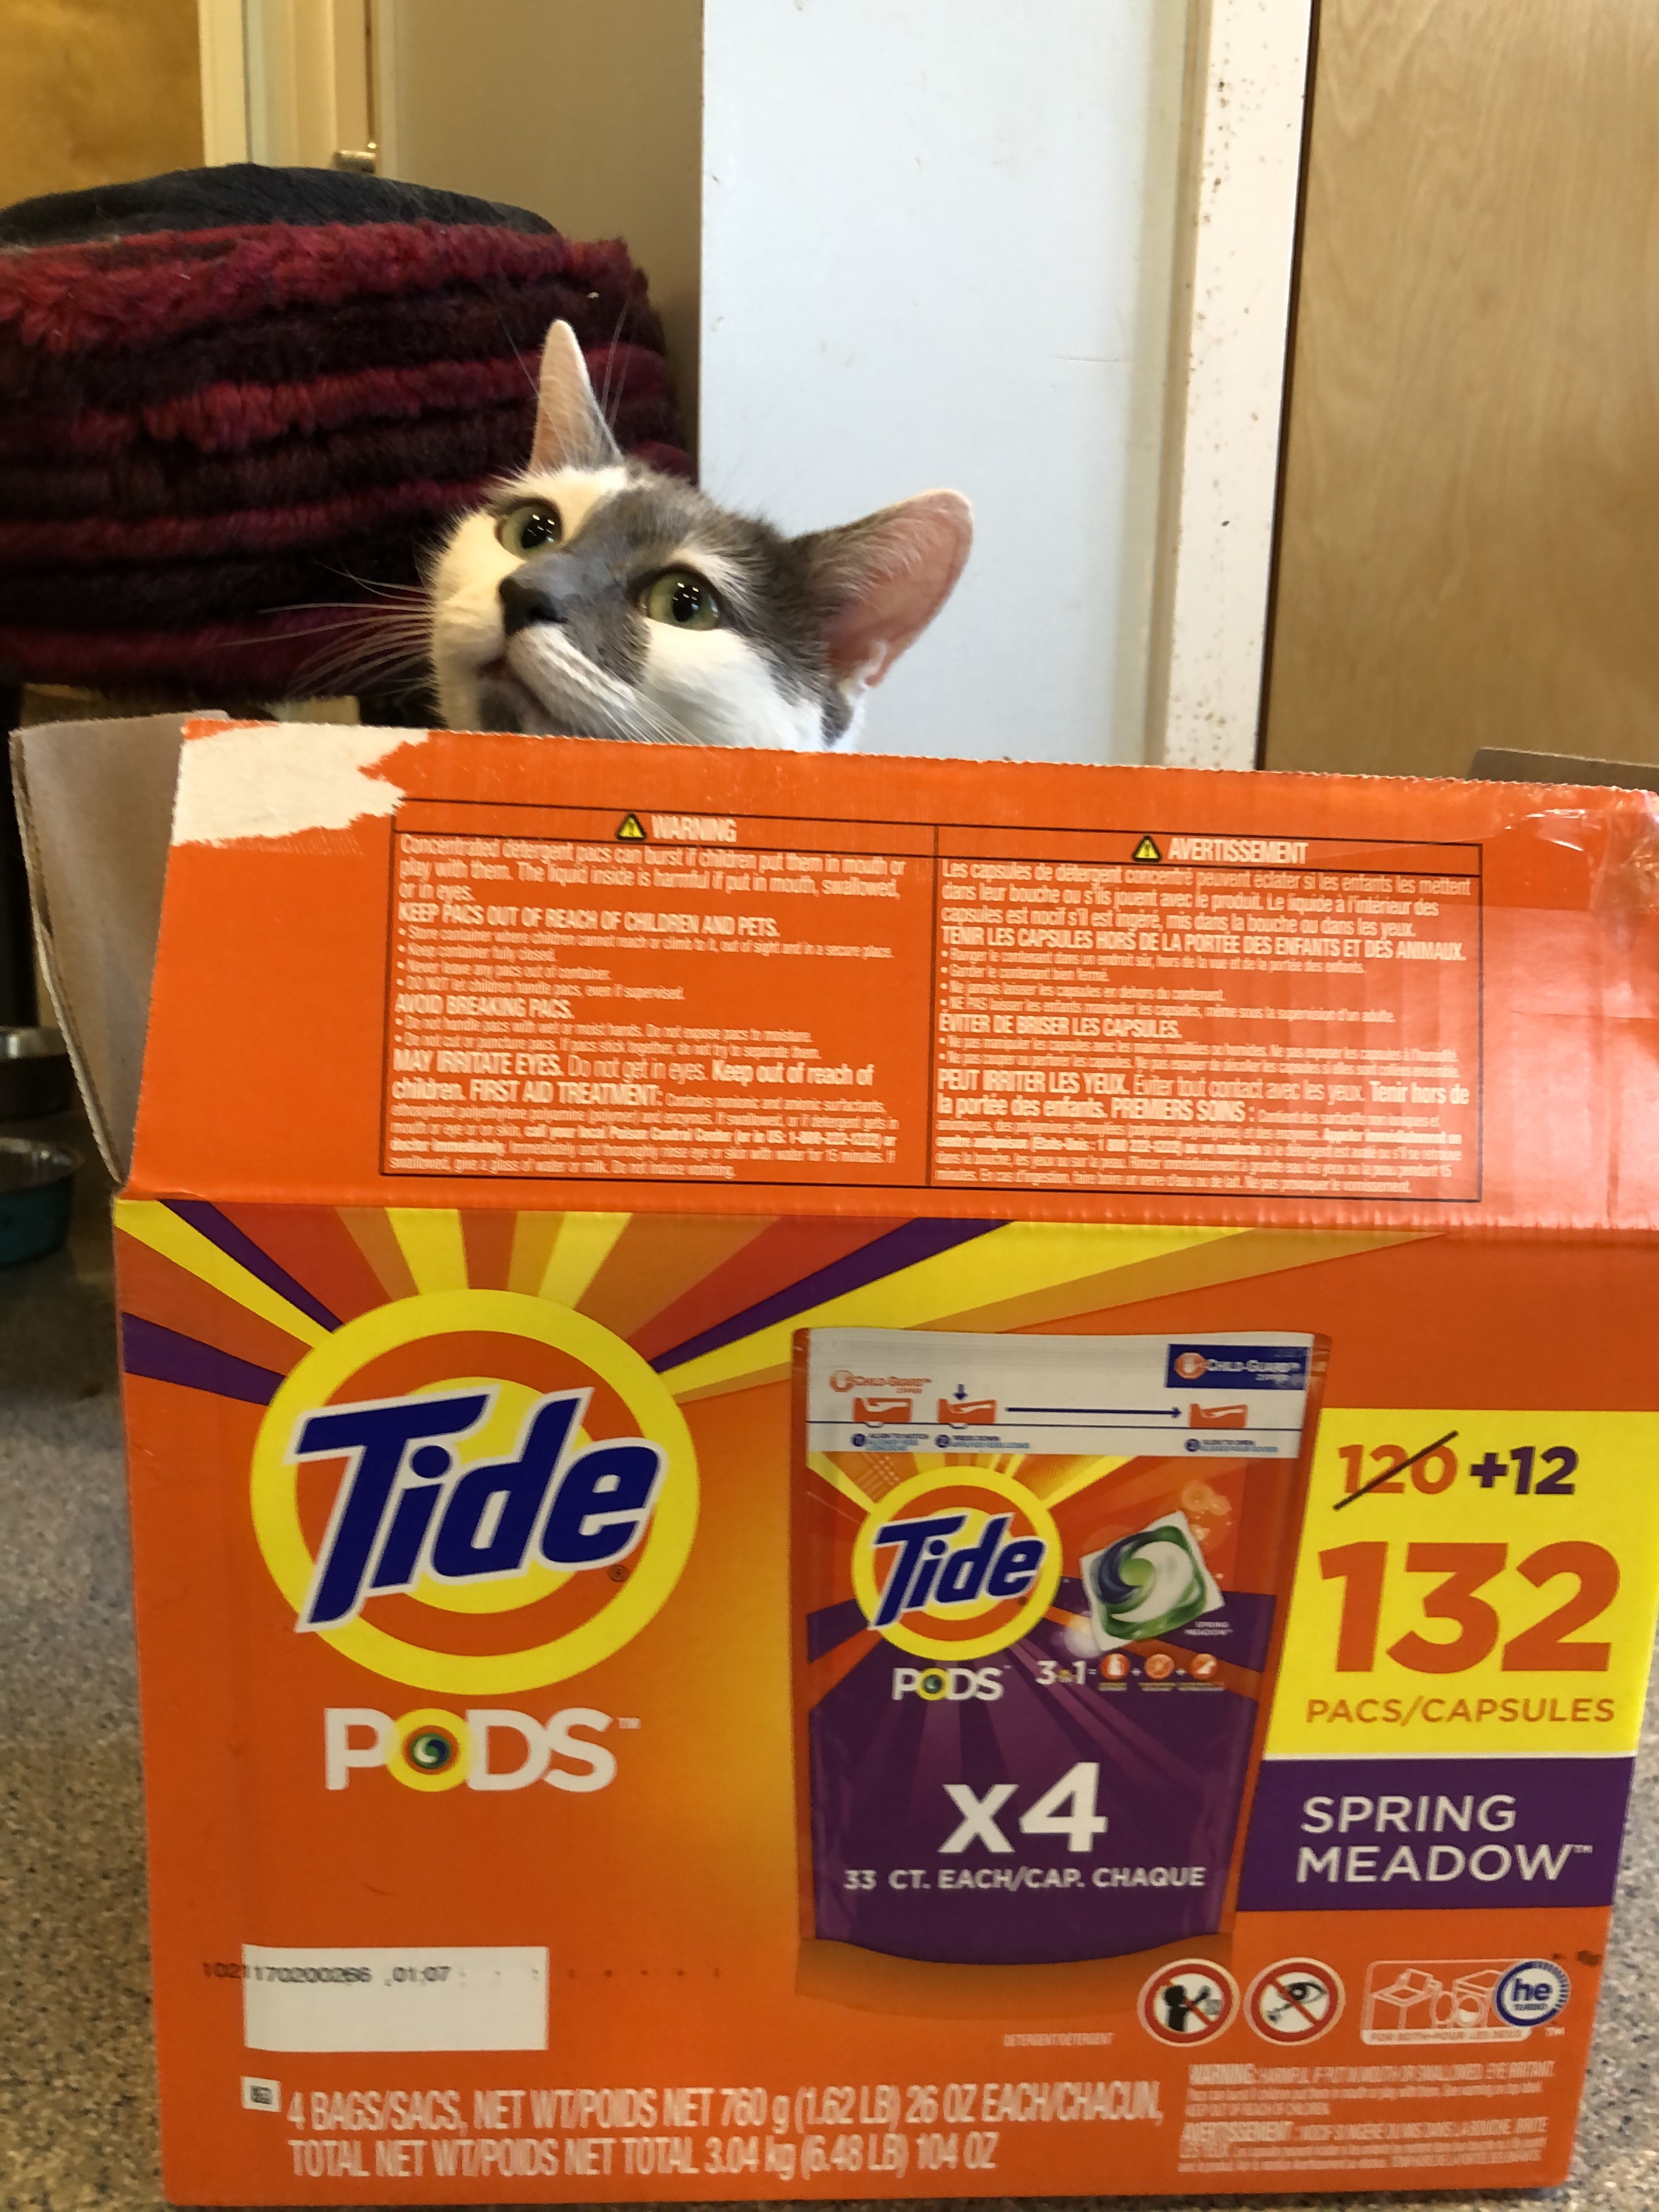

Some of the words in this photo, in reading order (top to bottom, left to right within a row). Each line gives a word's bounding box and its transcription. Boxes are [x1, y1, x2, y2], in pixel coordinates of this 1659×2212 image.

[651, 815, 737, 842] WARNING
[1169, 837, 1307, 864] AVERTISSEMENT
[1338, 1443, 1458, 1494] 120
[1470, 1446, 1578, 1494] +12
[284, 1384, 667, 1633] Tide
[868, 1513, 1046, 1630] Tide
[1319, 1541, 1620, 1674] 132
[892, 1667, 1005, 1701] PODS
[1306, 1696, 1615, 1725] PACS/CAPSULES
[325, 1706, 618, 1792] PODS
[1300, 1794, 1516, 1833] SPRING
[843, 1869, 877, 1891] 33
[888, 1869, 931, 1891] CT.
[938, 1866, 1085, 1892] EACH/CAP.
[1092, 1866, 1206, 1888] CHAQUE
[1296, 1844, 1571, 1883] MEADOW
[1511, 1978, 1553, 2001] he
[287, 2090, 304, 2130] 4
[311, 2089, 468, 2136] BAGS/SACS,
[474, 2089, 527, 2130] NET
[663, 2087, 711, 2128] NET
[720, 2086, 768, 2127] 760
[771, 2094, 790, 2134] g
[795, 2086, 854, 2134] (1.62
[860, 2085, 901, 2133] LB)
[905, 2084, 939, 2125] 26
[943, 2083, 978, 2124] OZ
[982, 2080, 1164, 2126] EACH/CHACUN,
[287, 2138, 370, 2177] TOTAL
[375, 2138, 430, 2177] NET
[564, 2137, 618, 2176] NET
[621, 2136, 699, 2175] TOTAL
[705, 2135, 759, 2175] 3.04
[765, 2134, 797, 2180] kg
[800, 2134, 863, 2180] (6.48
[867, 2133, 908, 2179] LB)
[916, 2132, 960, 2171] 104
[963, 2130, 1001, 2169] OZ
